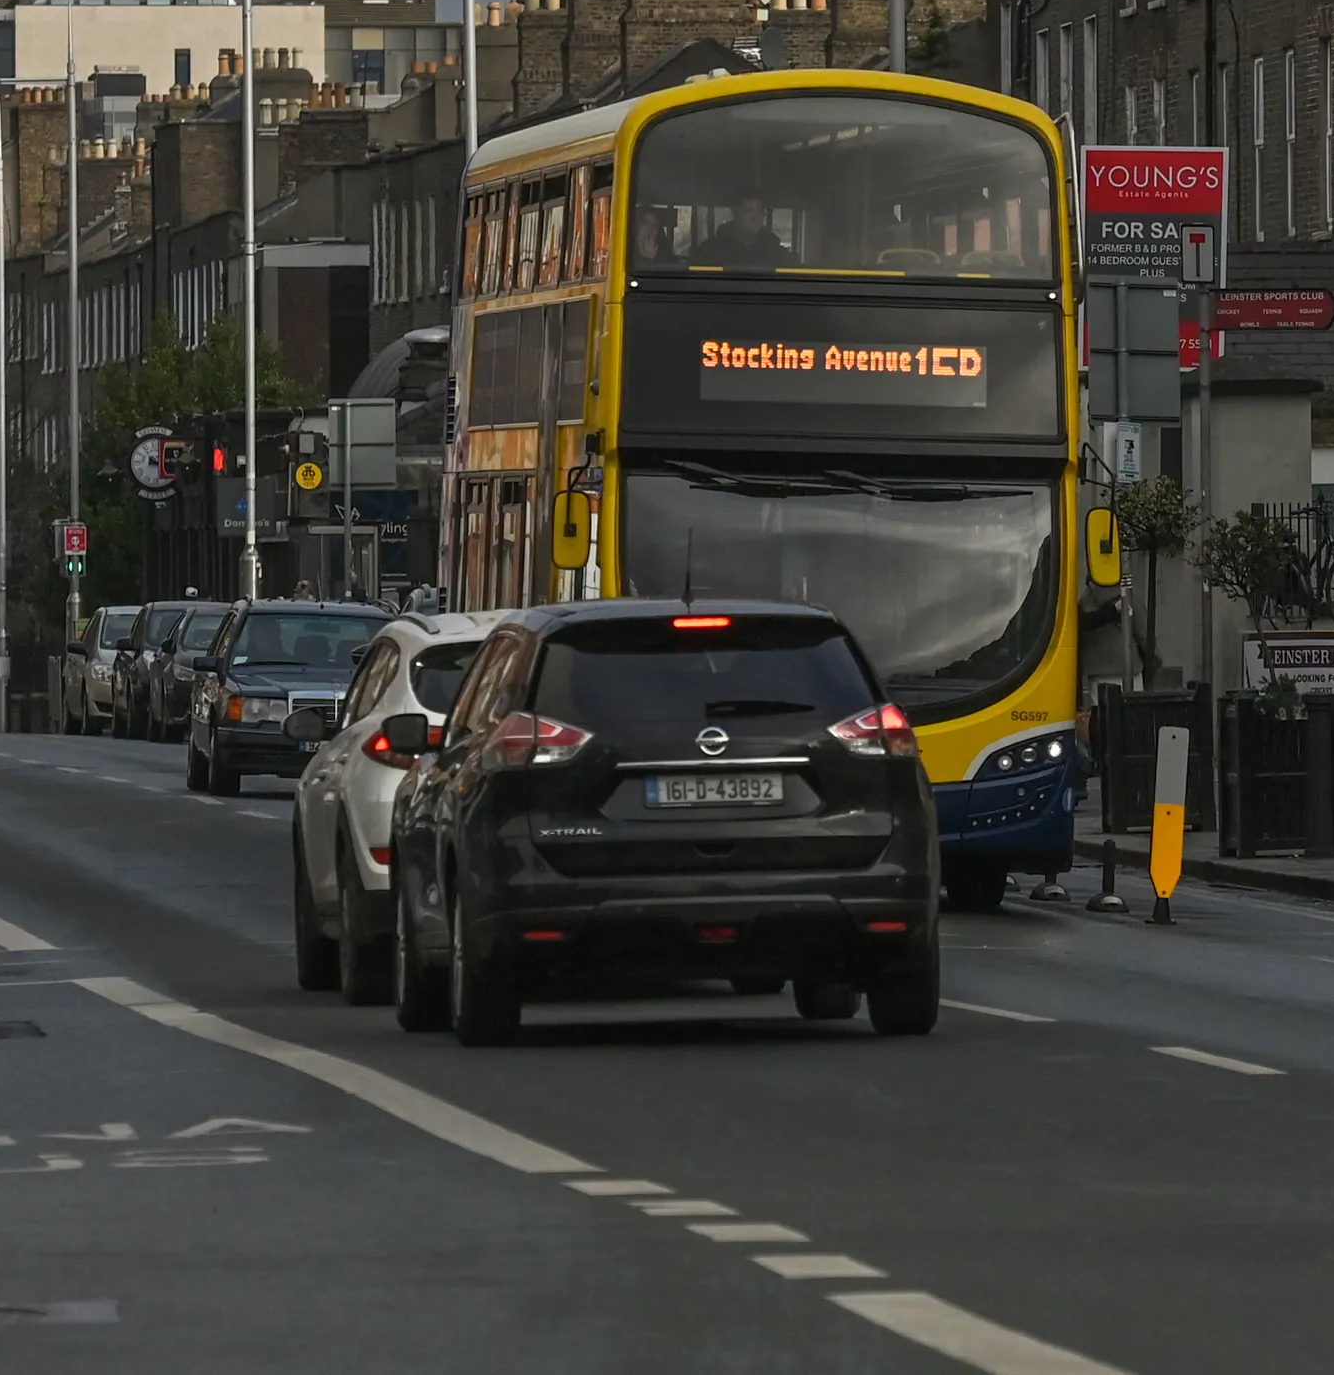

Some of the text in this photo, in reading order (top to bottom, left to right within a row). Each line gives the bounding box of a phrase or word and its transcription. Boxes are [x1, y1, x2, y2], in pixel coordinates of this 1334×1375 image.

[1090, 165, 1219, 188] YOUNG'S
[1119, 190, 1189, 199] Estate Agents
[1102, 221, 1182, 239] FOR SA
[1091, 243, 1133, 253] FORMER
[1087, 256, 1098, 264] 14
[1100, 256, 1149, 265] BEDROOM
[1140, 269, 1165, 278] PLUS
[1220, 292, 1325, 301] LEINSTER SPORTS CLUB
[702, 341, 815, 370] Stocking
[825, 345, 912, 372] Avenue
[1010, 710, 1049, 722] SG597
[664, 777, 775, 801] 161-D-43892
[539, 827, 603, 837] X-TRAIL
